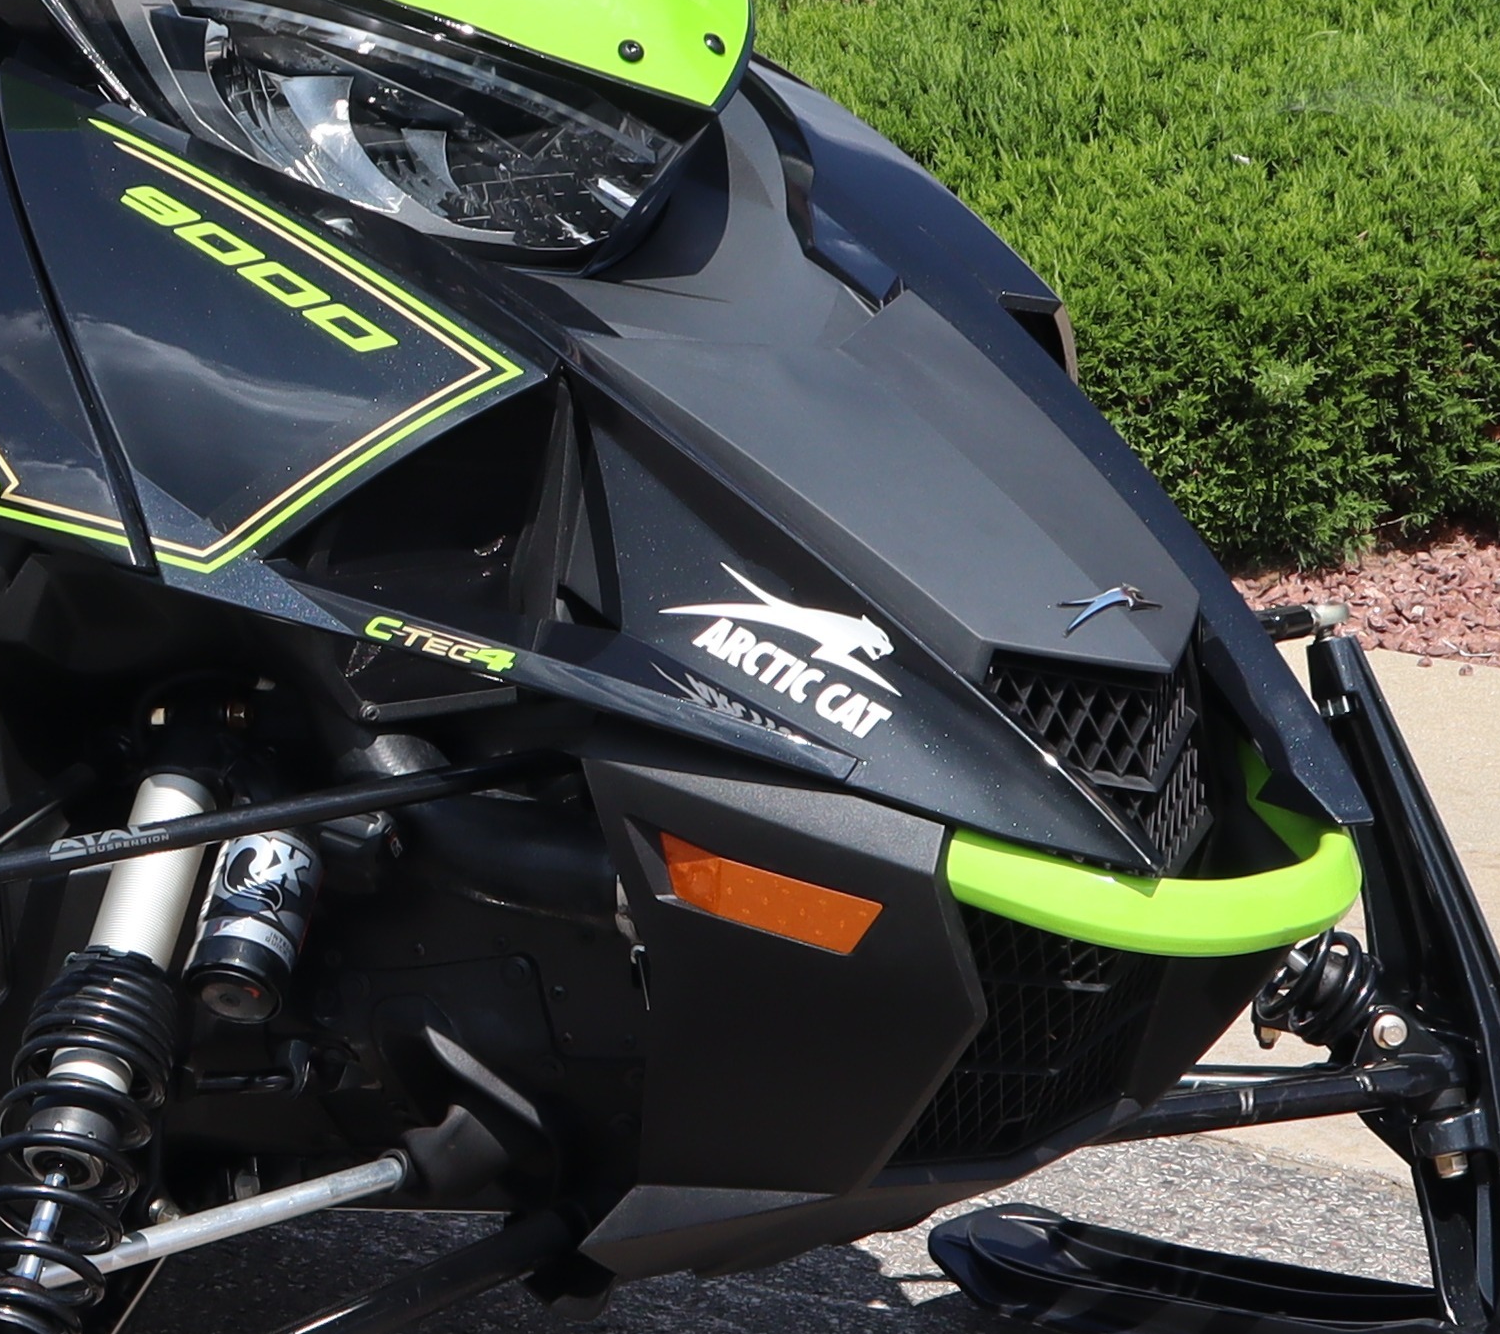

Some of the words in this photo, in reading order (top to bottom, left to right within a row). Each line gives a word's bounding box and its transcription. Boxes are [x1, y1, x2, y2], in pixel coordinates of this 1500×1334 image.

[120, 185, 398, 352] 9000
[365, 616, 516, 672] C-TEC4
[691, 618, 826, 703] ARCTIC
[814, 683, 893, 739] CAT
[88, 834, 170, 855] SUSPENSION
